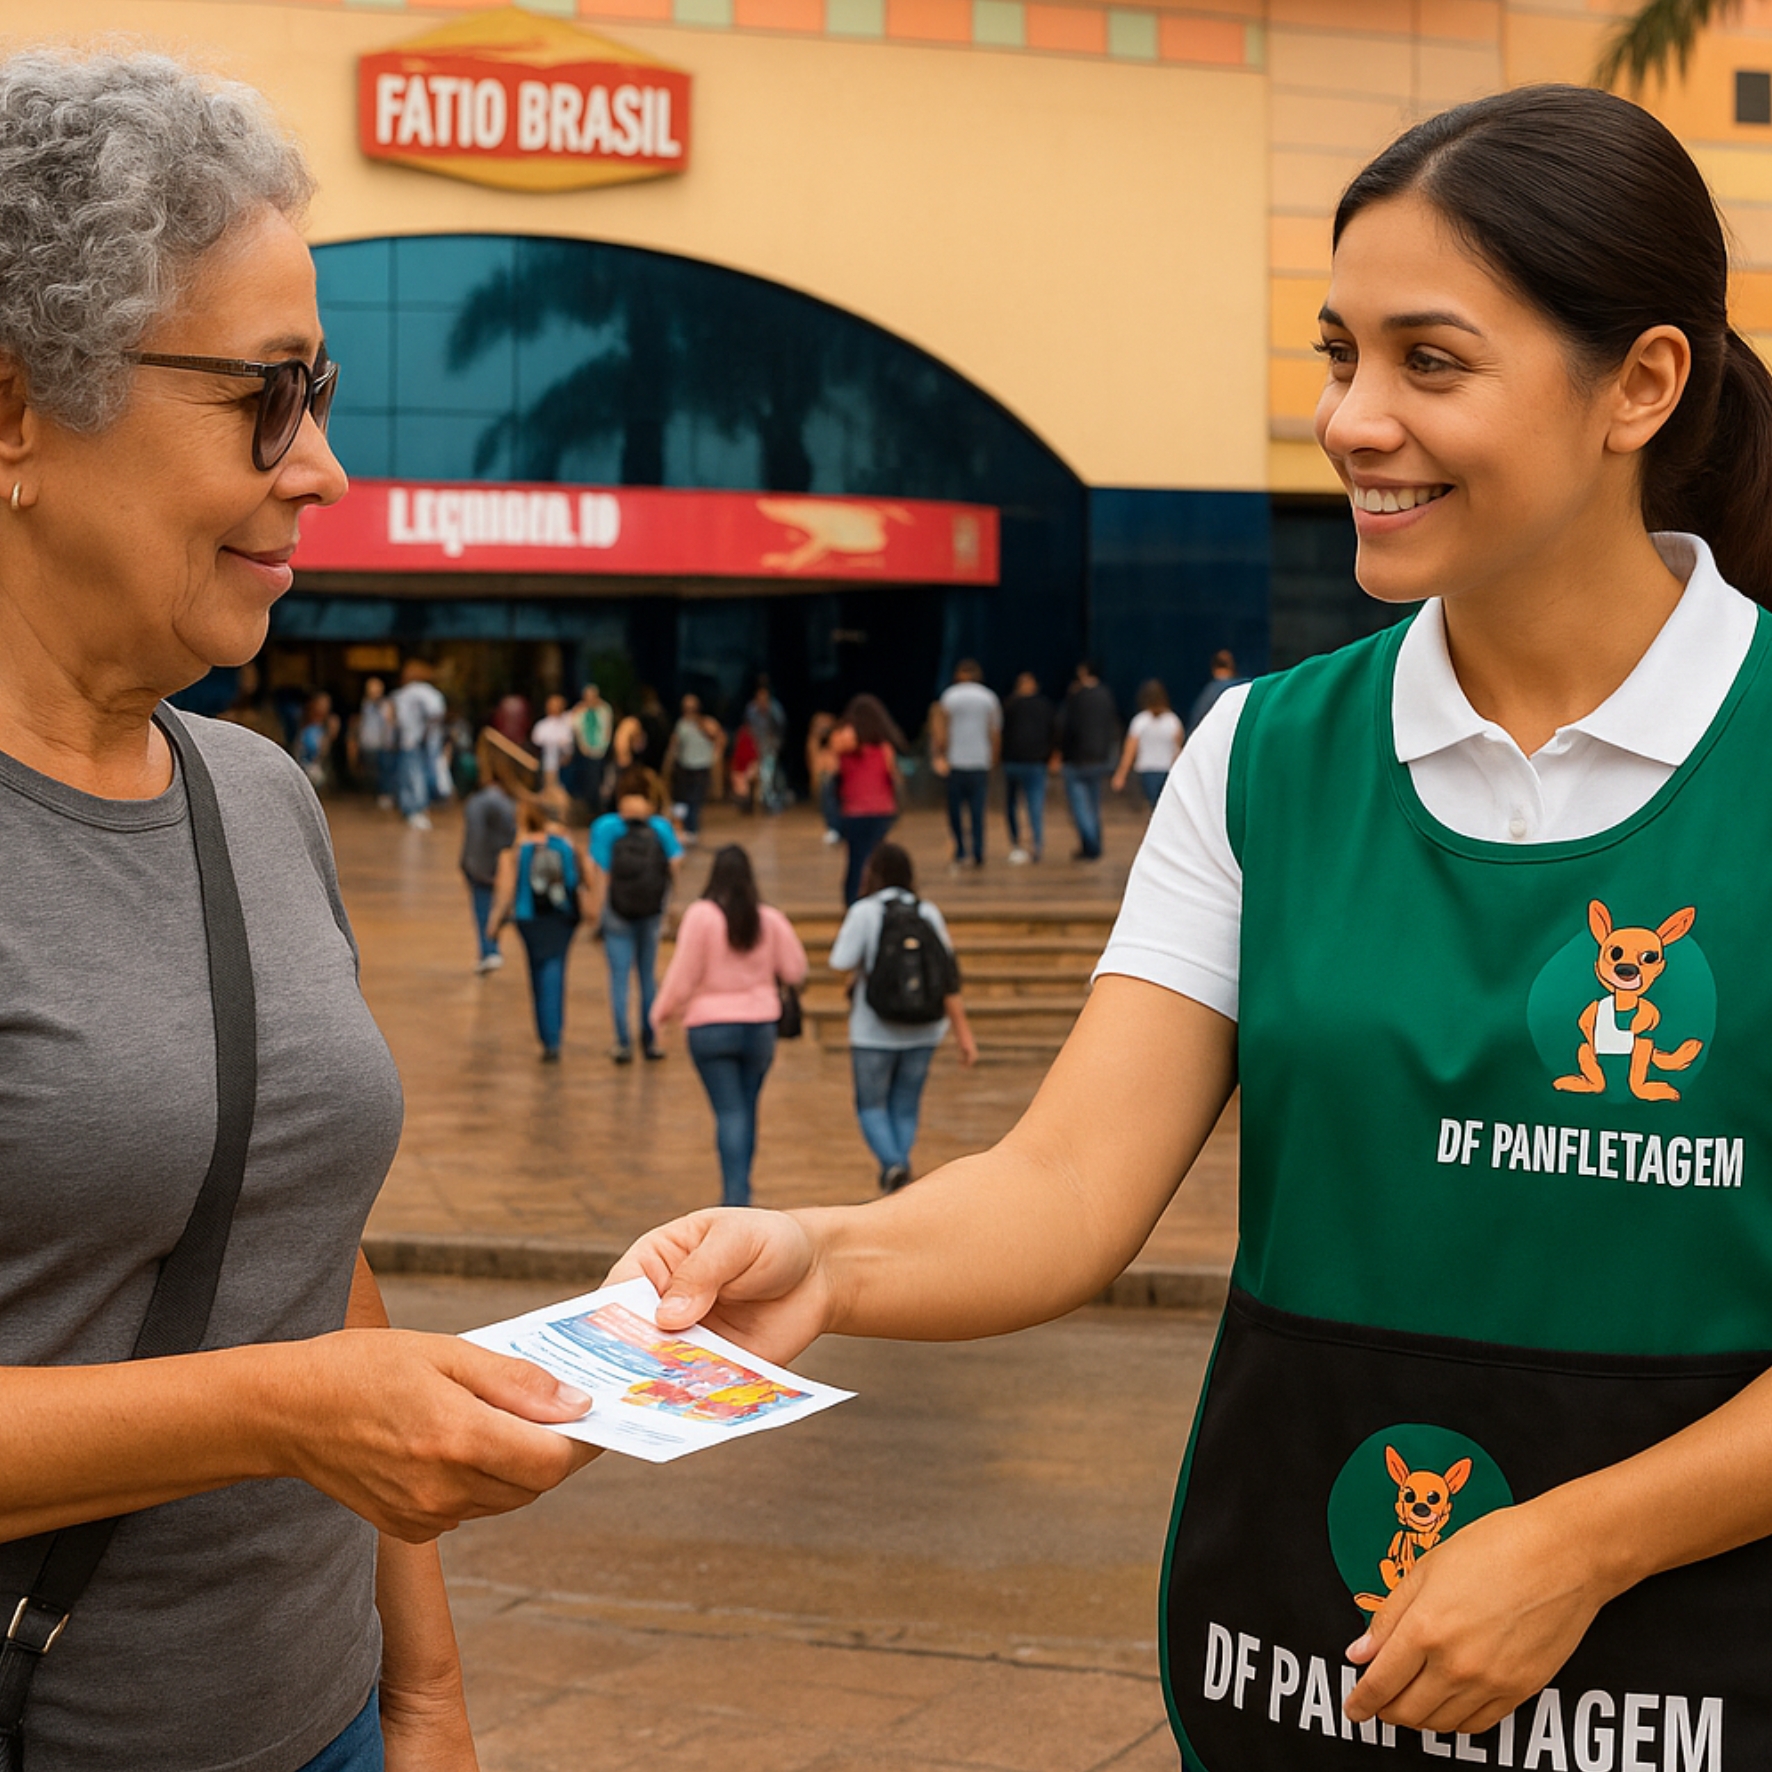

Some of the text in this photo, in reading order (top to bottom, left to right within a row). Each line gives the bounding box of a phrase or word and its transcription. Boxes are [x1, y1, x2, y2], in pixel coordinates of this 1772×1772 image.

[376, 74, 682, 157] FATIO BRASIL
[1437, 1118, 1744, 1188] DF PANFLETAGEM
[1203, 1622, 1724, 1772] DF PANAGEM
